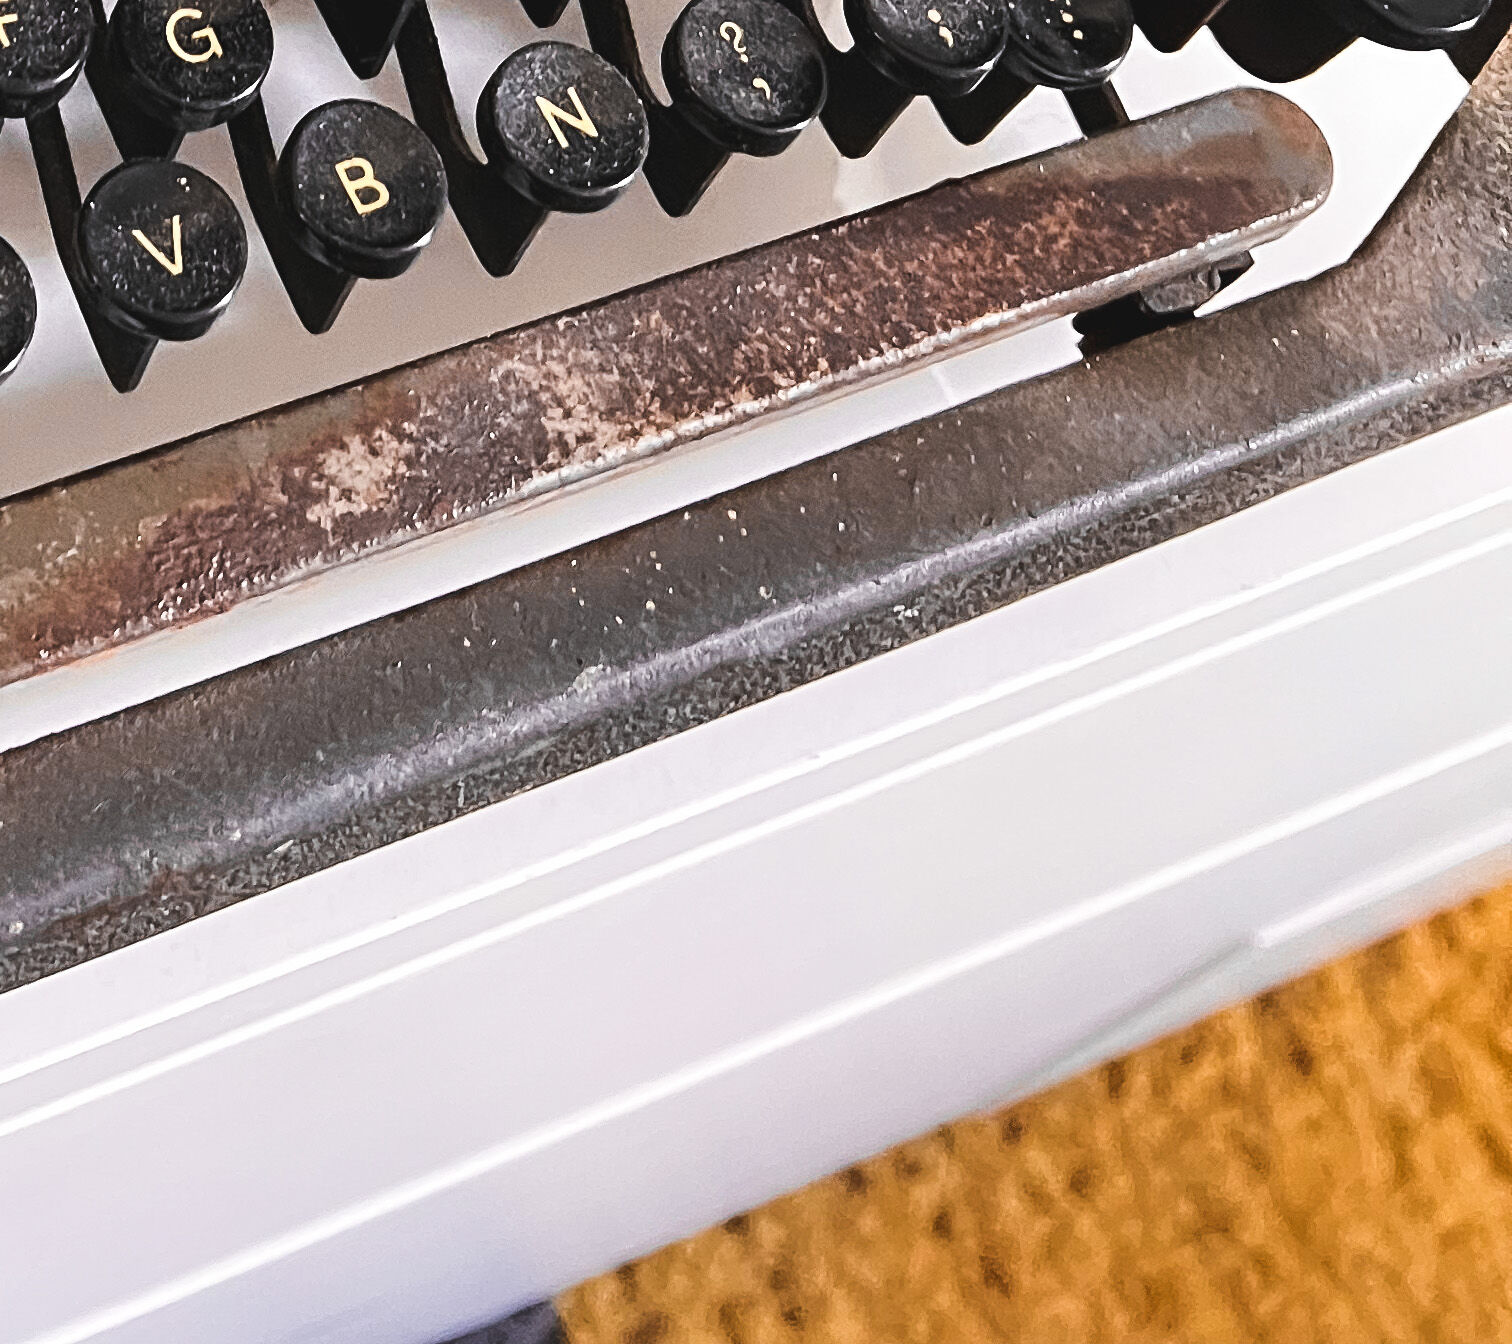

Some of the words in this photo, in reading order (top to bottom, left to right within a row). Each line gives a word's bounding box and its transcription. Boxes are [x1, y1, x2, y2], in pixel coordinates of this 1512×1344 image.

[165, 8, 223, 64] G
[719, 21, 749, 63] ?
[531, 86, 599, 149] N
[334, 157, 390, 215] B
[131, 214, 182, 276] V
